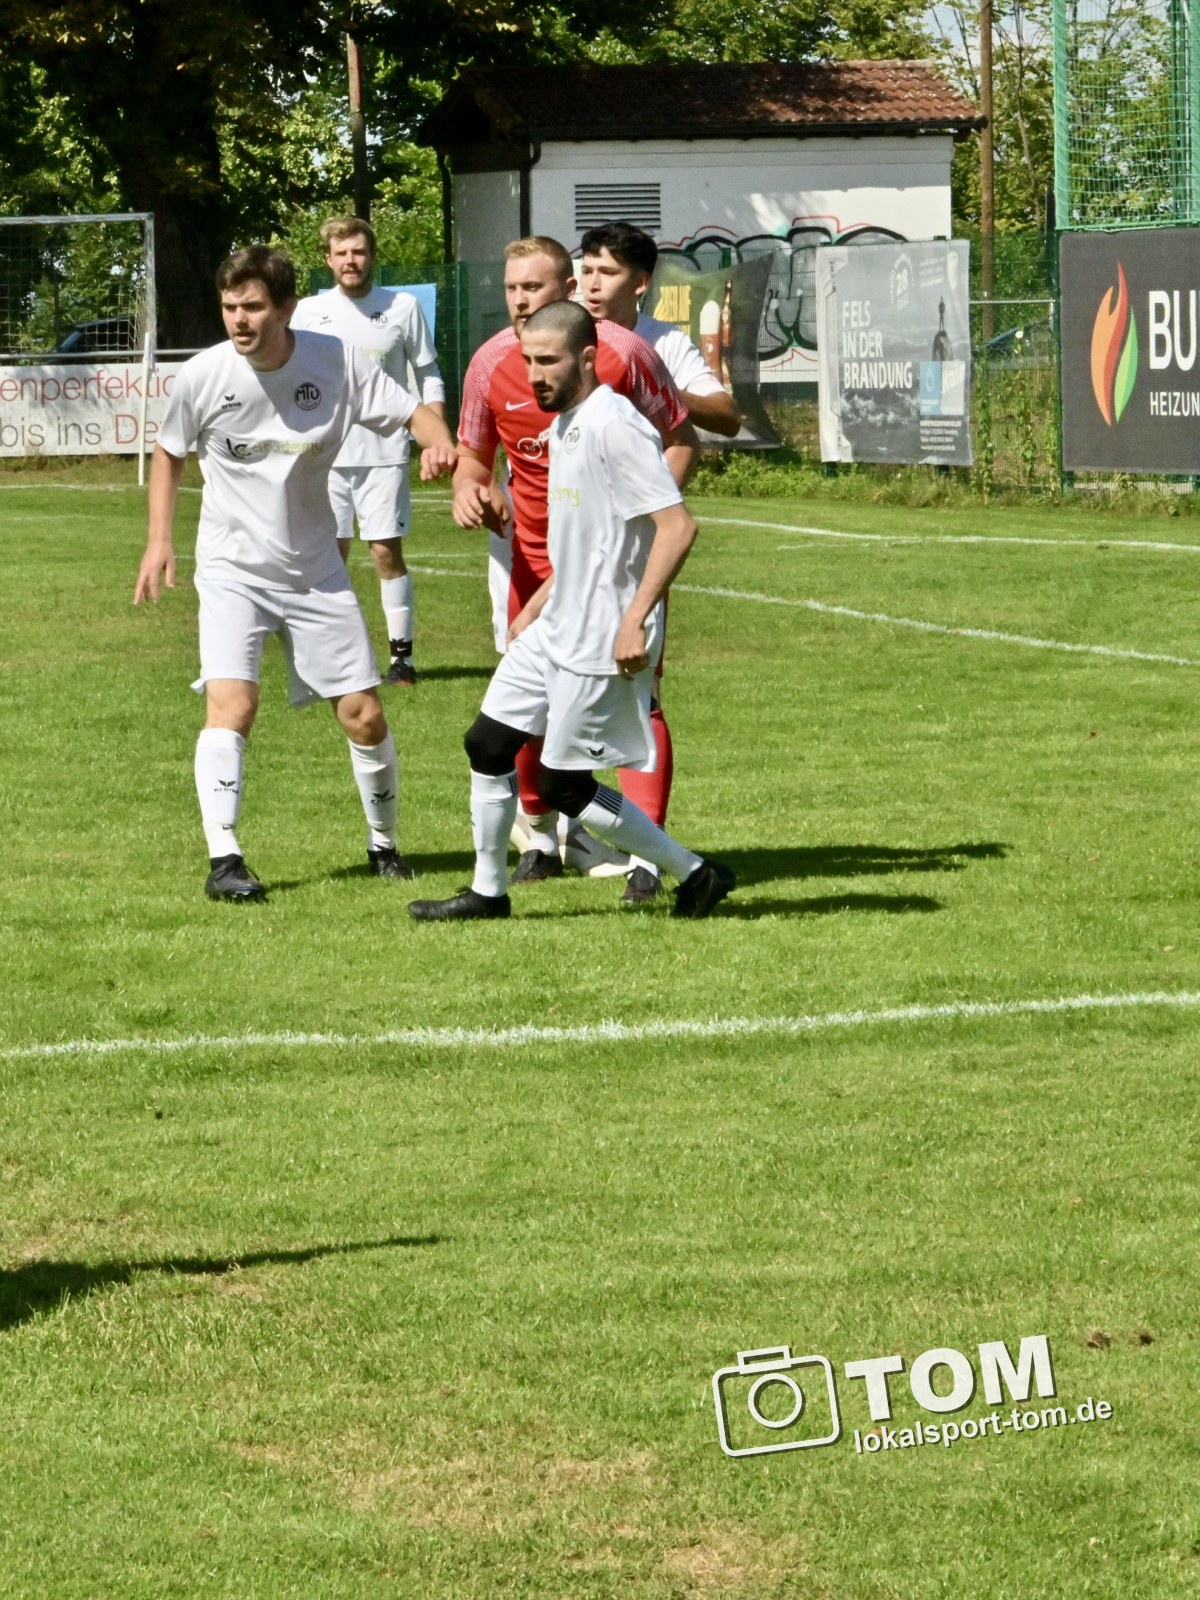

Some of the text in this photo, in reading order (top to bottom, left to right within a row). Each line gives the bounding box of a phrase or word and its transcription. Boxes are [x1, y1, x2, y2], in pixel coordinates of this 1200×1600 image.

[842, 299, 872, 329] FELS
[842, 330, 884, 359] IN DER
[1148, 289, 1200, 372] BU
[843, 360, 914, 390] BRANDUNG
[1149, 391, 1200, 417] HEIZUN
[56, 415, 103, 447] ins
[114, 413, 162, 445] De
